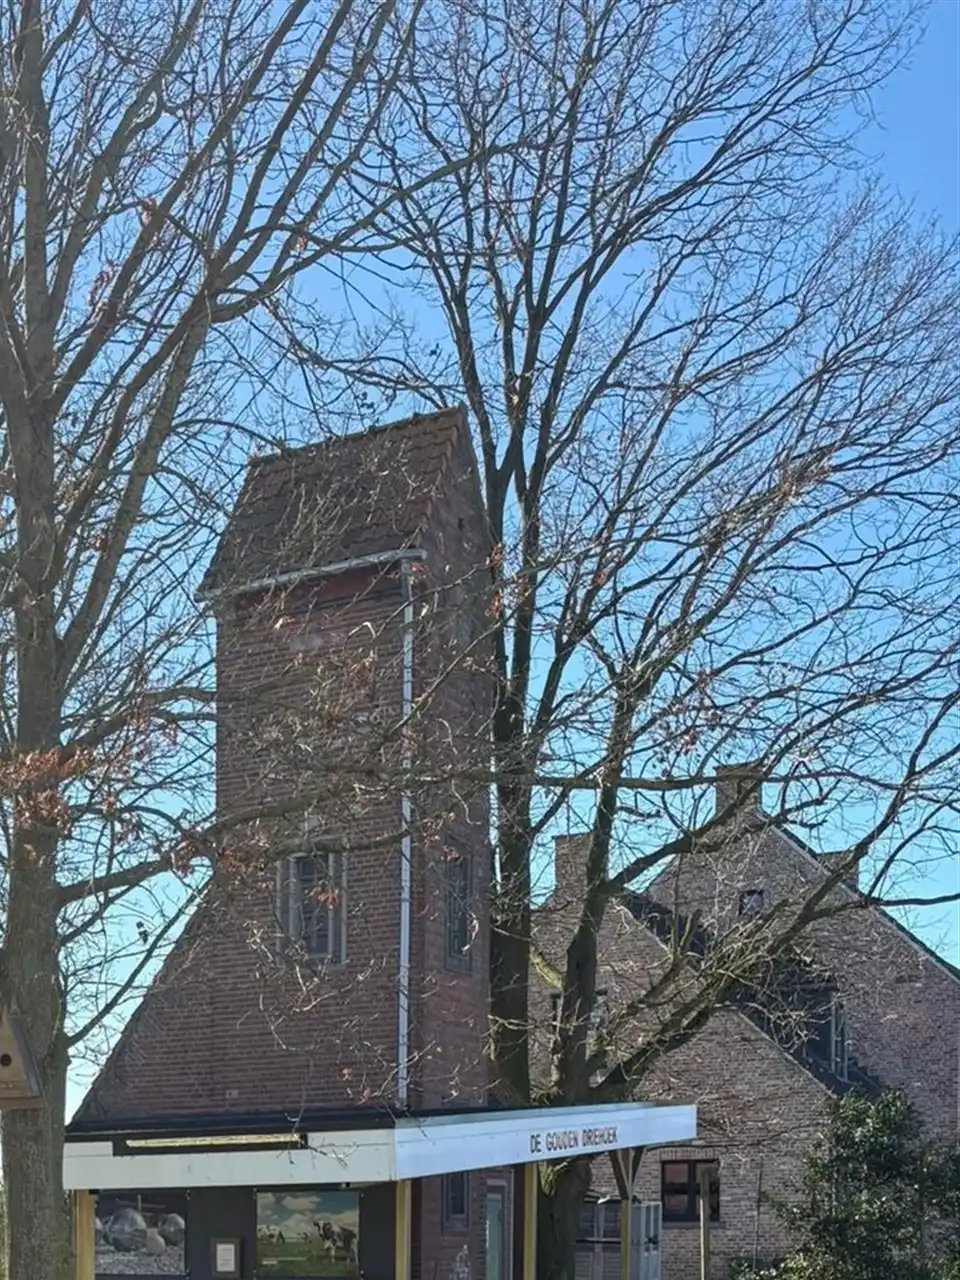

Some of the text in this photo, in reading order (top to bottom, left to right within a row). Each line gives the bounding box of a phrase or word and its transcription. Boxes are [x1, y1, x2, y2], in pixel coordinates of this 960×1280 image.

[530, 1127, 618, 1153] DE GOUDEN DRIEHOEK
